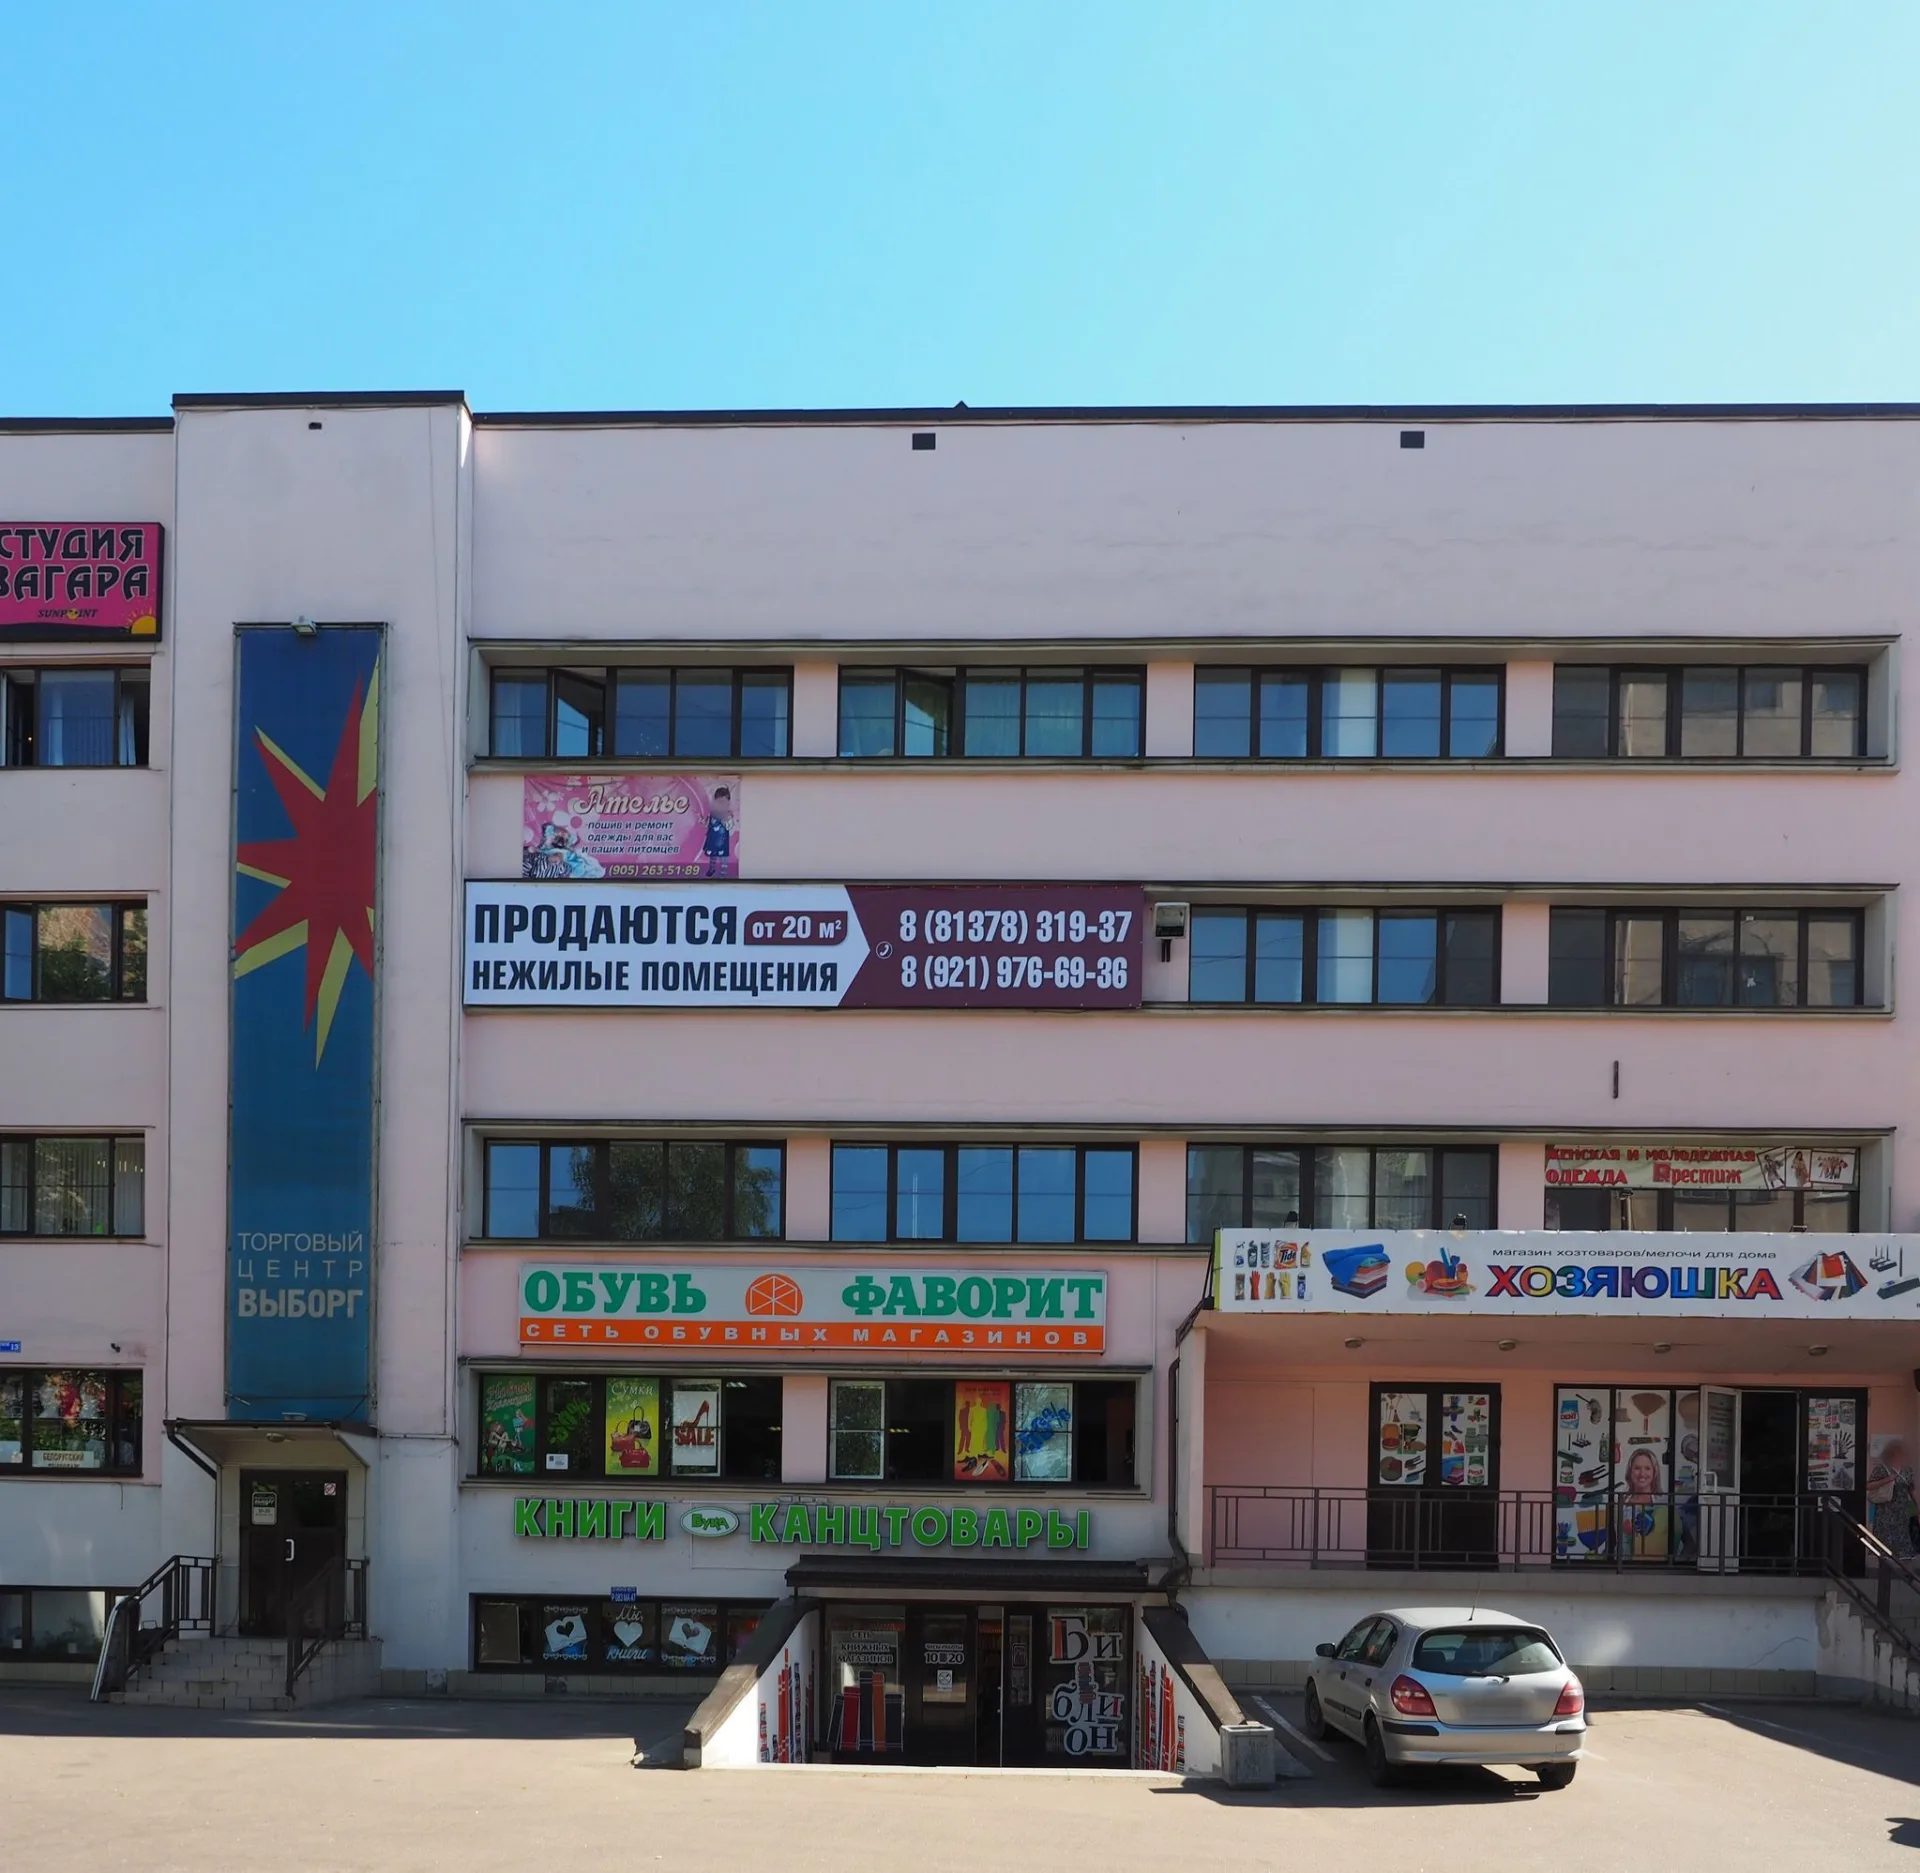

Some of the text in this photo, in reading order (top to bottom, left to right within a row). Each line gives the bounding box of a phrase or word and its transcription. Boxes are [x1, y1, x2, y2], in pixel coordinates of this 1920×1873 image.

[573, 784, 689, 815] Ателье
[588, 822, 622, 830] пошив
[635, 822, 673, 831] ремонт
[588, 834, 631, 842] одежды
[634, 834, 653, 842] для
[591, 846, 624, 854] ваших
[627, 846, 679, 855] питомцев
[609, 864, 700, 876] (905) 263-51-89
[474, 904, 737, 951] ПРОДАЮТСЯ
[752, 922, 773, 938] от
[782, 916, 811, 939] 20
[900, 910, 1132, 944] 8 (81378) 319-37
[472, 960, 838, 997] НЕЖИЛЫЕ ПОМЕЩЕНИЯ
[901, 955, 1127, 990] 8 (921) 976-69-36
[1627, 1149, 1639, 1160] И
[1646, 1150, 1756, 1162] МОЛОДЕЖНАЯ
[1545, 1169, 1628, 1184] ОДЕЖДА
[238, 1230, 363, 1252] ТОРГОВЫЙ
[1280, 1249, 1296, 1263] Tide
[1705, 1251, 1733, 1259] для
[1738, 1252, 1776, 1260] дома
[238, 1260, 363, 1280] ЦЕНТР
[1485, 1265, 1783, 1300] ХОЗЯЮШКА
[524, 1270, 1102, 1318] ОБУВЬ ФАВОРИТ
[238, 1288, 364, 1318] ВЫБОРГ
[526, 1323, 1087, 1345] СЕТЬ ОБУВНЫХ МАГАЗИНОВ
[611, 1382, 654, 1397] Сумки
[675, 1427, 714, 1446] SALE
[513, 1498, 666, 1540] КНИГИ
[750, 1504, 1090, 1550] КАНЦТОВАРЫ
[851, 1630, 873, 1639] СЕТЬ
[841, 1643, 890, 1652] КНИЖНЫХ
[837, 1654, 893, 1663] МАГАЗИНОВ
[925, 1652, 964, 1664] 10 20
